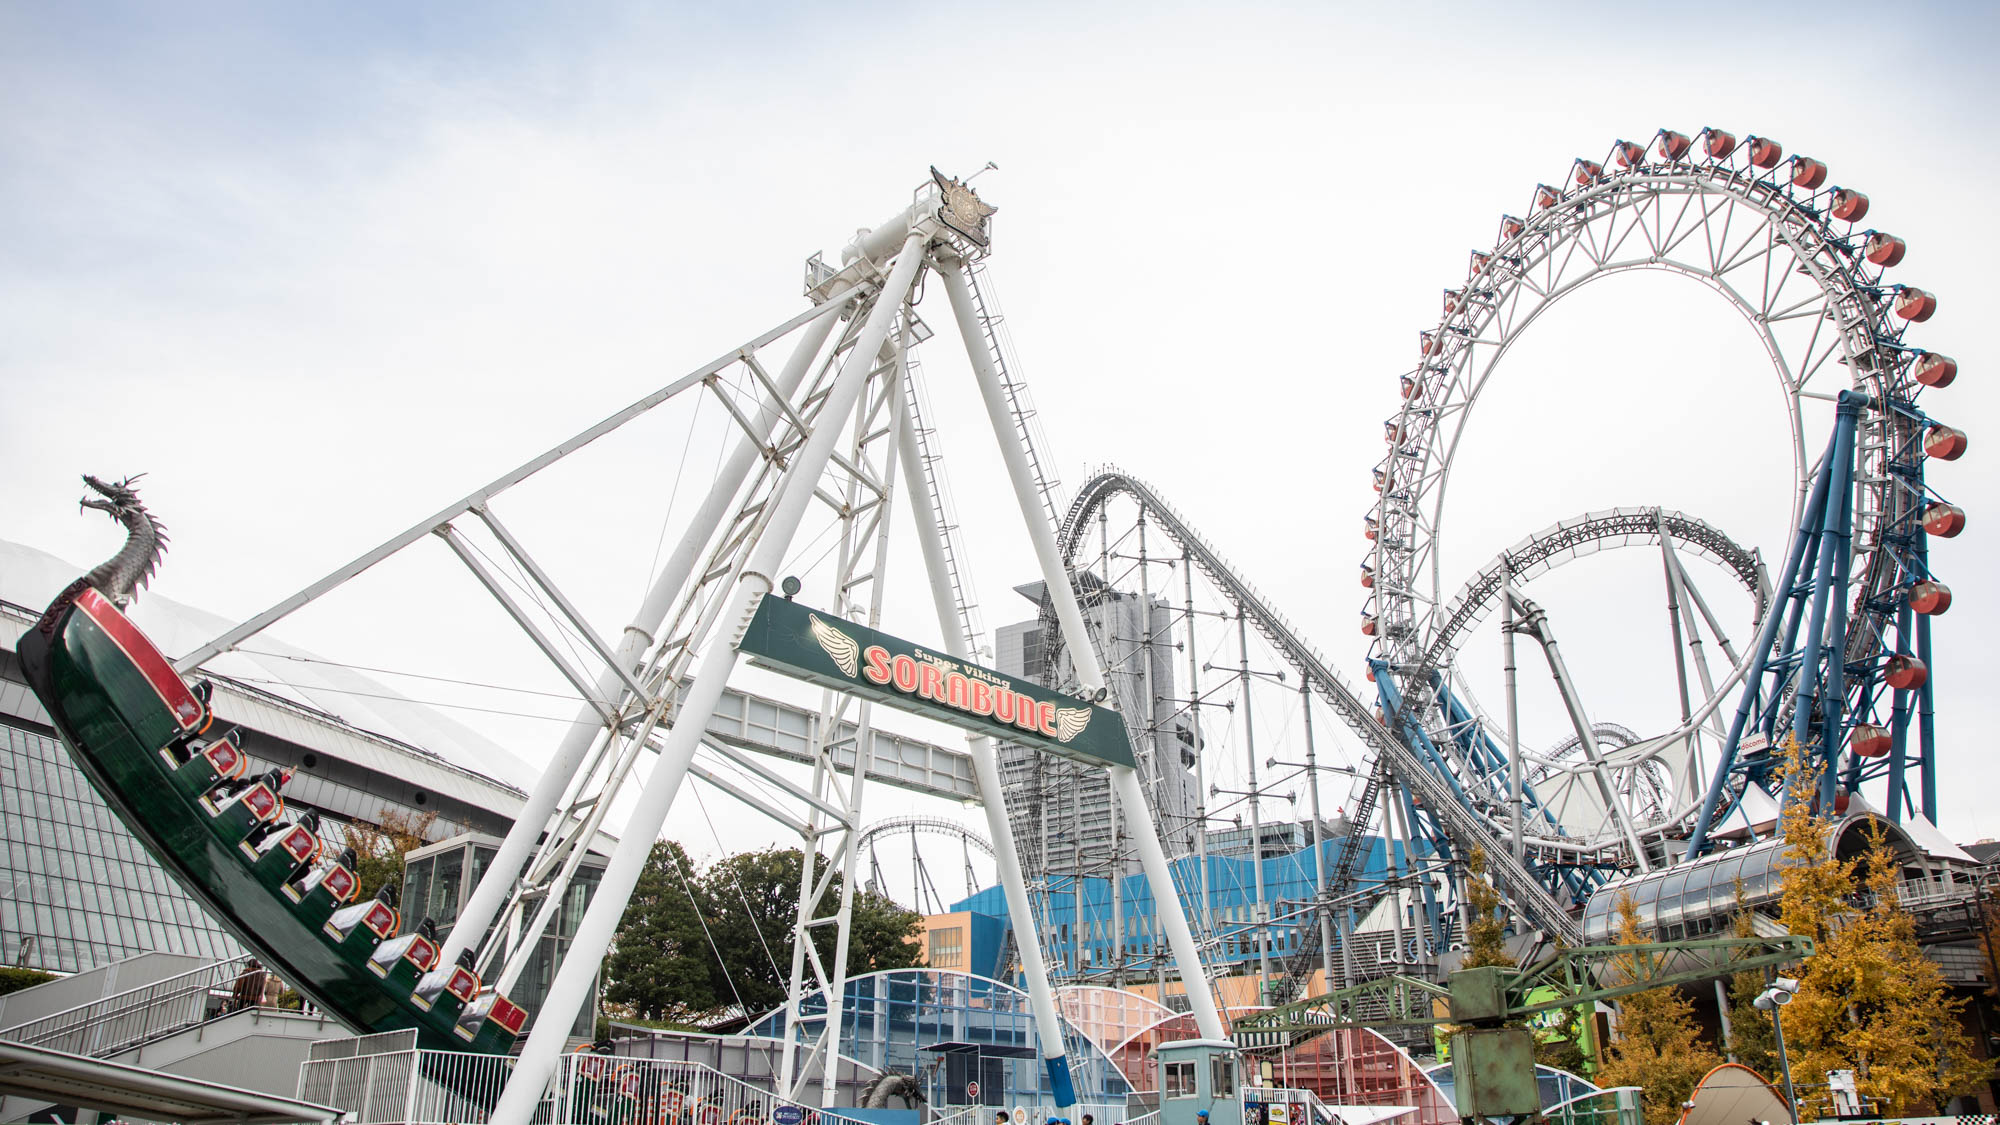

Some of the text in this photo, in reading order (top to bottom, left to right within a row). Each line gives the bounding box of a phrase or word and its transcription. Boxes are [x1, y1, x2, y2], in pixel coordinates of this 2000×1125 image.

[863, 645, 1058, 738] SORABUNE
[914, 648, 1011, 689] Super Viking
